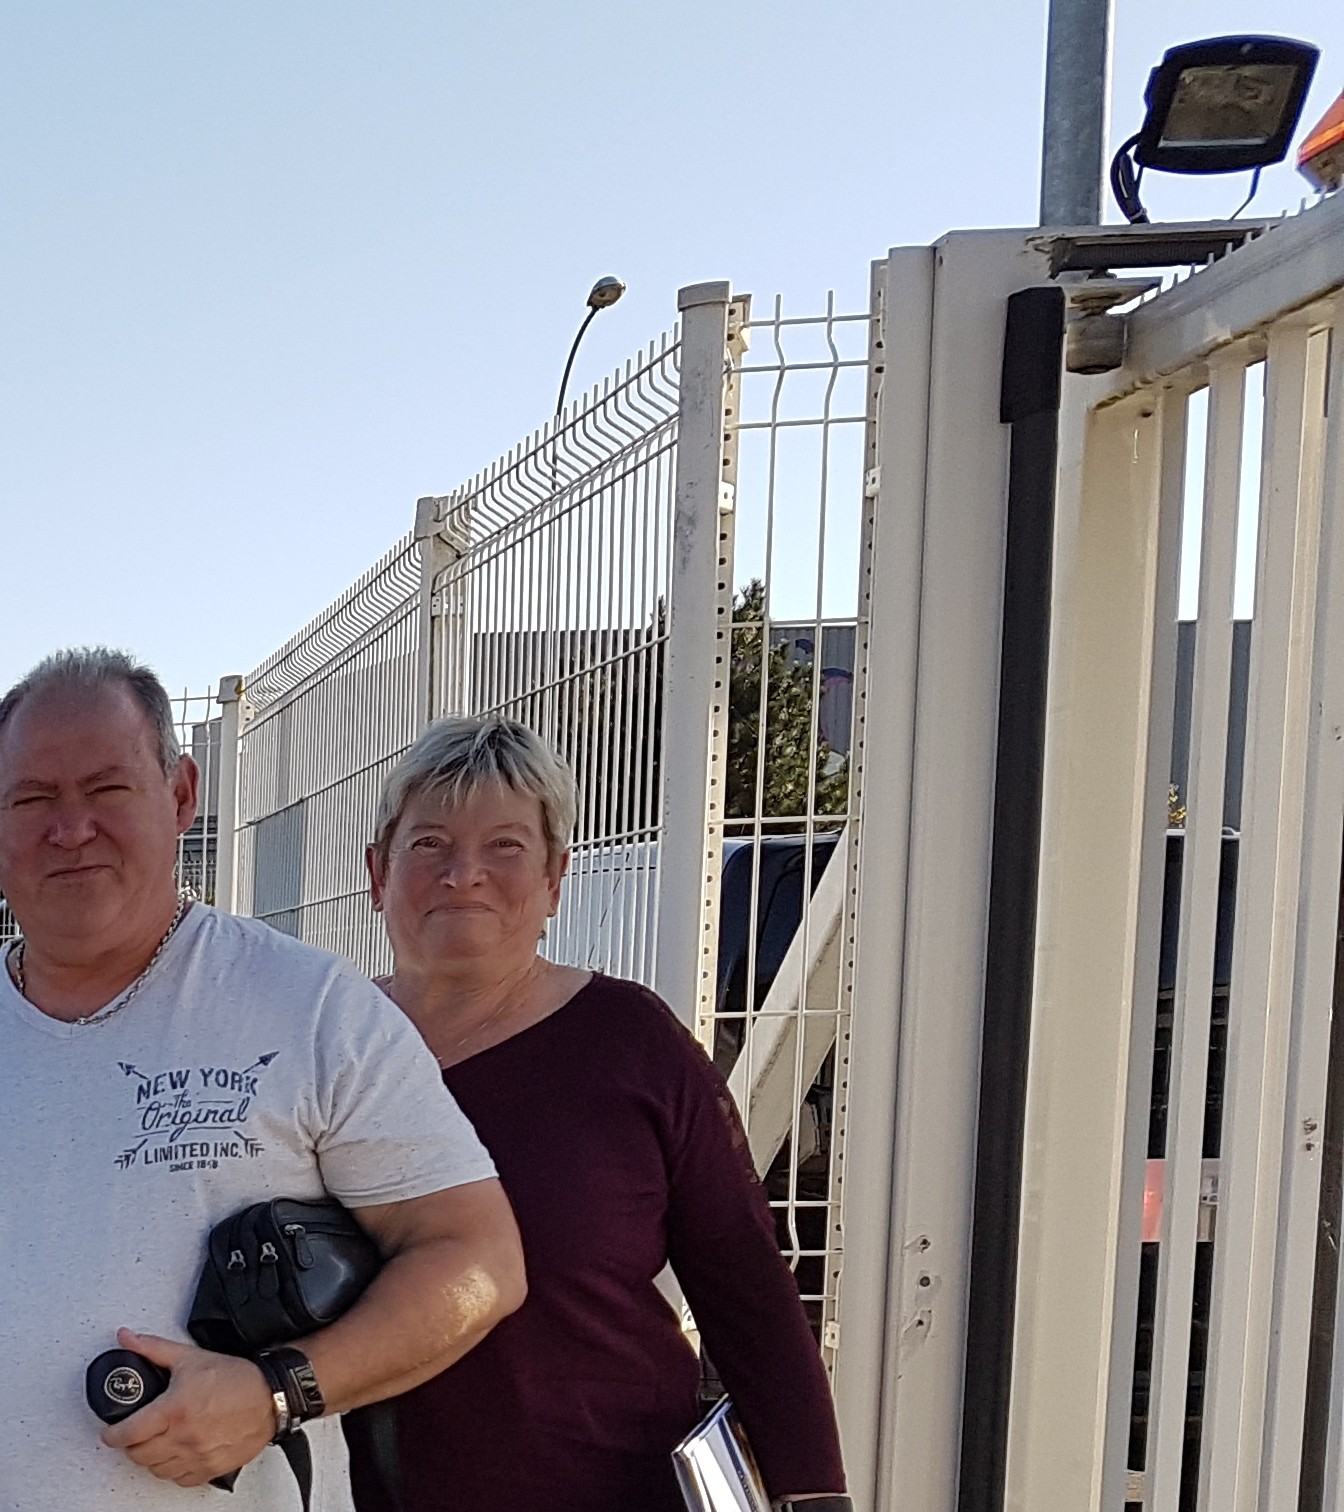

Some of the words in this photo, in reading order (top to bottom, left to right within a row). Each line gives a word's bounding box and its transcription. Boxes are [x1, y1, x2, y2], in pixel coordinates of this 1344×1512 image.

[137, 1069, 191, 1104] NEW
[200, 1068, 259, 1097] YORK
[173, 1089, 192, 1108] The
[142, 1097, 250, 1142] Original
[144, 1142, 210, 1165] LIMITED
[213, 1142, 243, 1159] INC.
